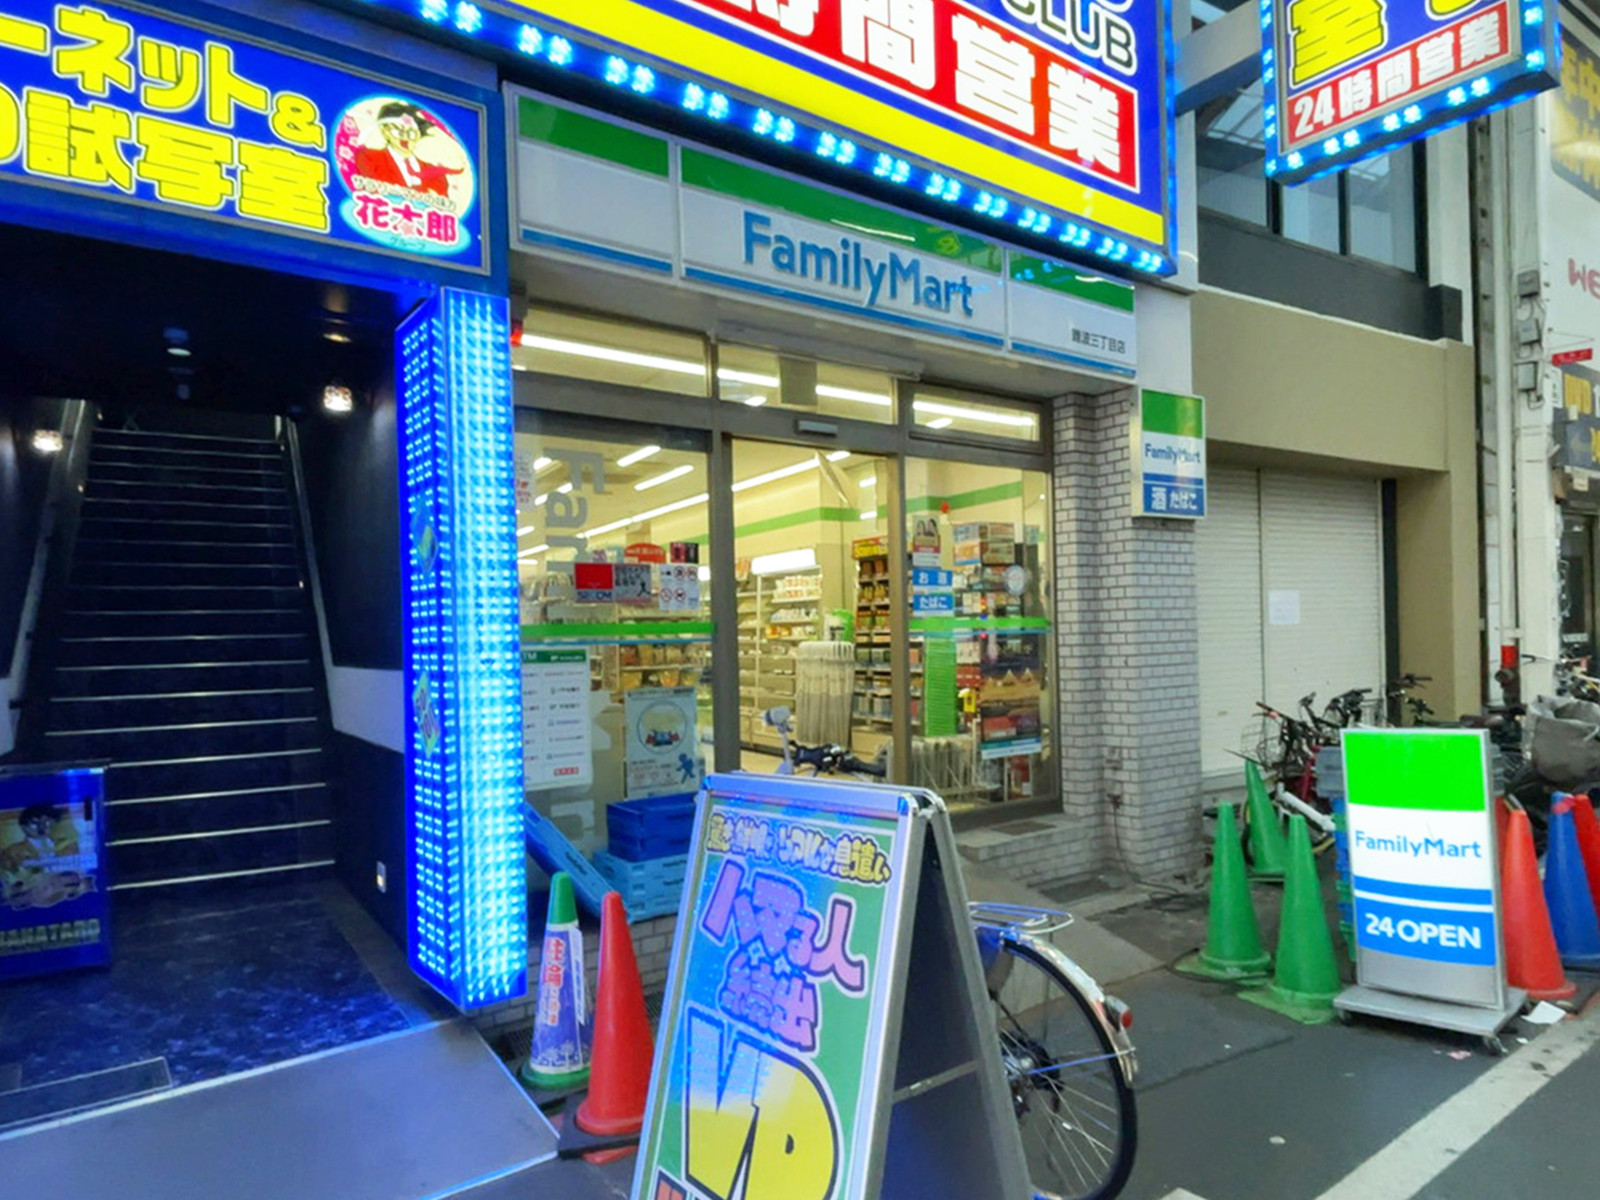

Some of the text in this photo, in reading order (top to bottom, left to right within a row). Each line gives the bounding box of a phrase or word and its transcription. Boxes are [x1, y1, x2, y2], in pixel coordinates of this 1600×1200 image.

[1294, 16, 1502, 139] 24時間営業
[0, 85, 329, 232] 試写室
[355, 193, 457, 243] 花太郎
[743, 209, 973, 318] FamilyMart
[1144, 443, 1201, 464] FamilyMart
[1169, 488, 1198, 510] たばこ
[919, 595, 949, 609] たばこ
[1355, 829, 1482, 859] FamilyMart
